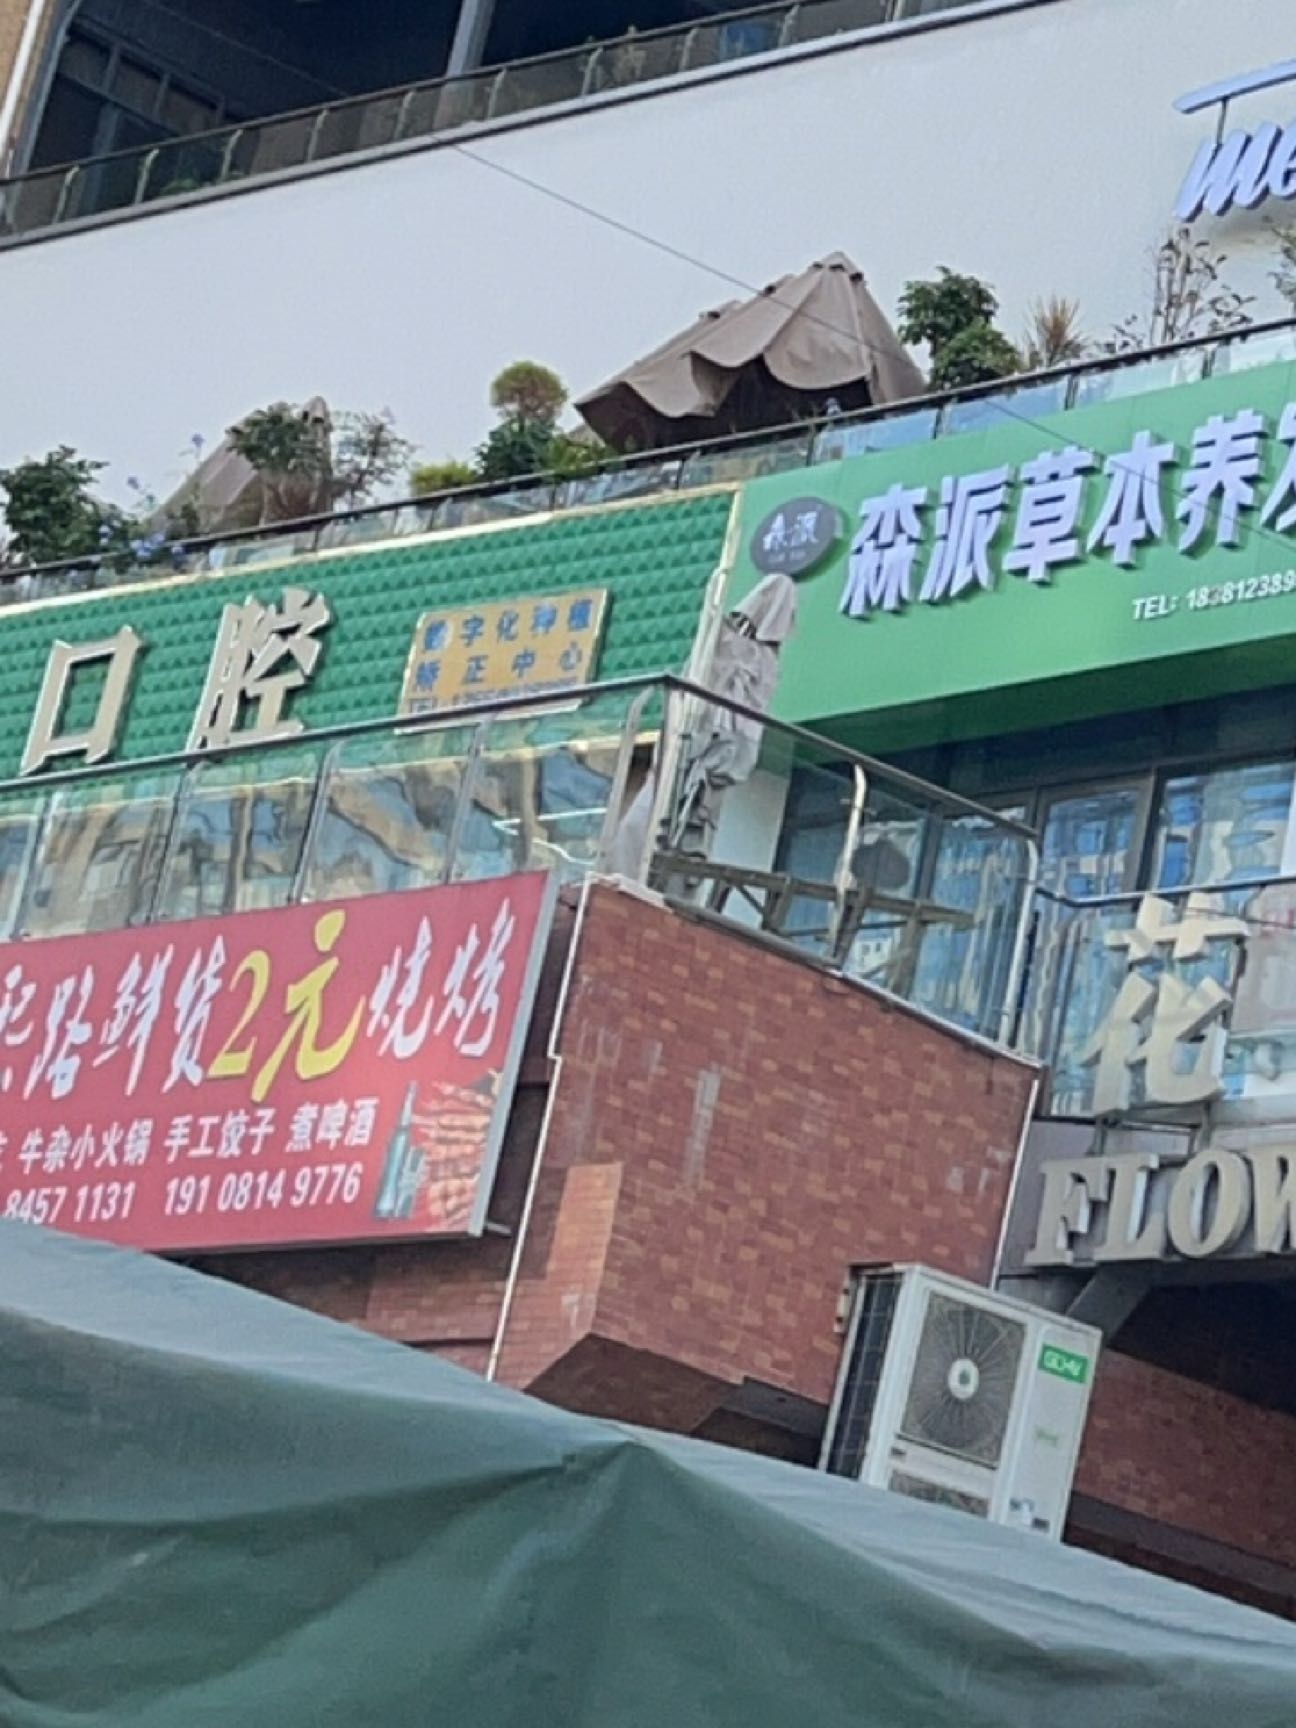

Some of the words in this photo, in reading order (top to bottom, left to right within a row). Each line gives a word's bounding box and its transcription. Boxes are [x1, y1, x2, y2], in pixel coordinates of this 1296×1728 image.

[20, 586, 333, 777] 口腔
[19, 1118, 154, 1174] 牛杂小火锅
[164, 1107, 276, 1163] 手工饺子
[285, 1097, 380, 1154] 煮啤酒
[74, 1181, 137, 1223] 1131
[165, 1174, 212, 1216] 191
[217, 1168, 286, 1212] 0814
[290, 1163, 364, 1208] 9776
